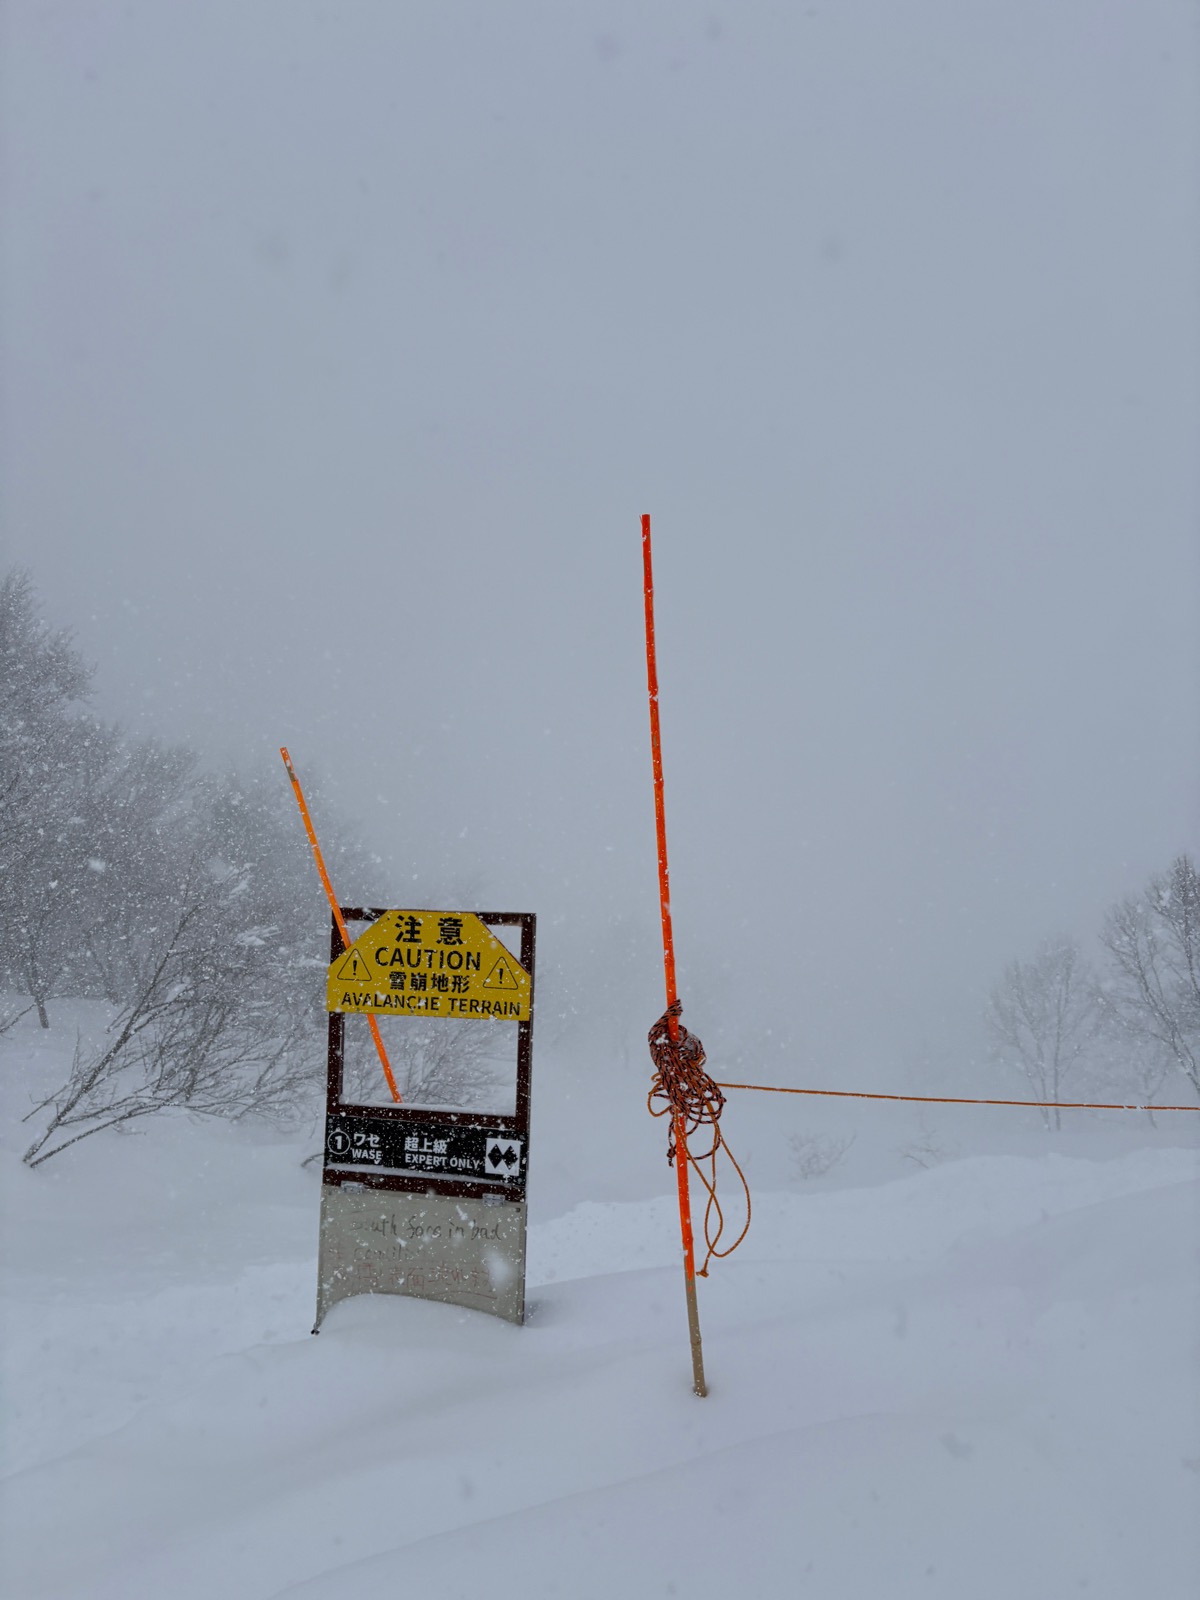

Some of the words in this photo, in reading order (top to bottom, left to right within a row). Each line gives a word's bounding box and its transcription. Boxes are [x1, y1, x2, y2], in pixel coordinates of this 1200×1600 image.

[395, 915, 463, 945] 注意
[375, 947, 481, 971] CAUTION
[389, 971, 470, 993] 雪崩地形
[341, 992, 439, 1011] AVALANCHE
[448, 997, 520, 1016] TERRAIN
[353, 1133, 380, 1148] ワセ
[404, 1137, 447, 1154] 超上級
[351, 1149, 382, 1160] WASE
[405, 1153, 447, 1167] EXPERT
[449, 1158, 480, 1170] ONLY
